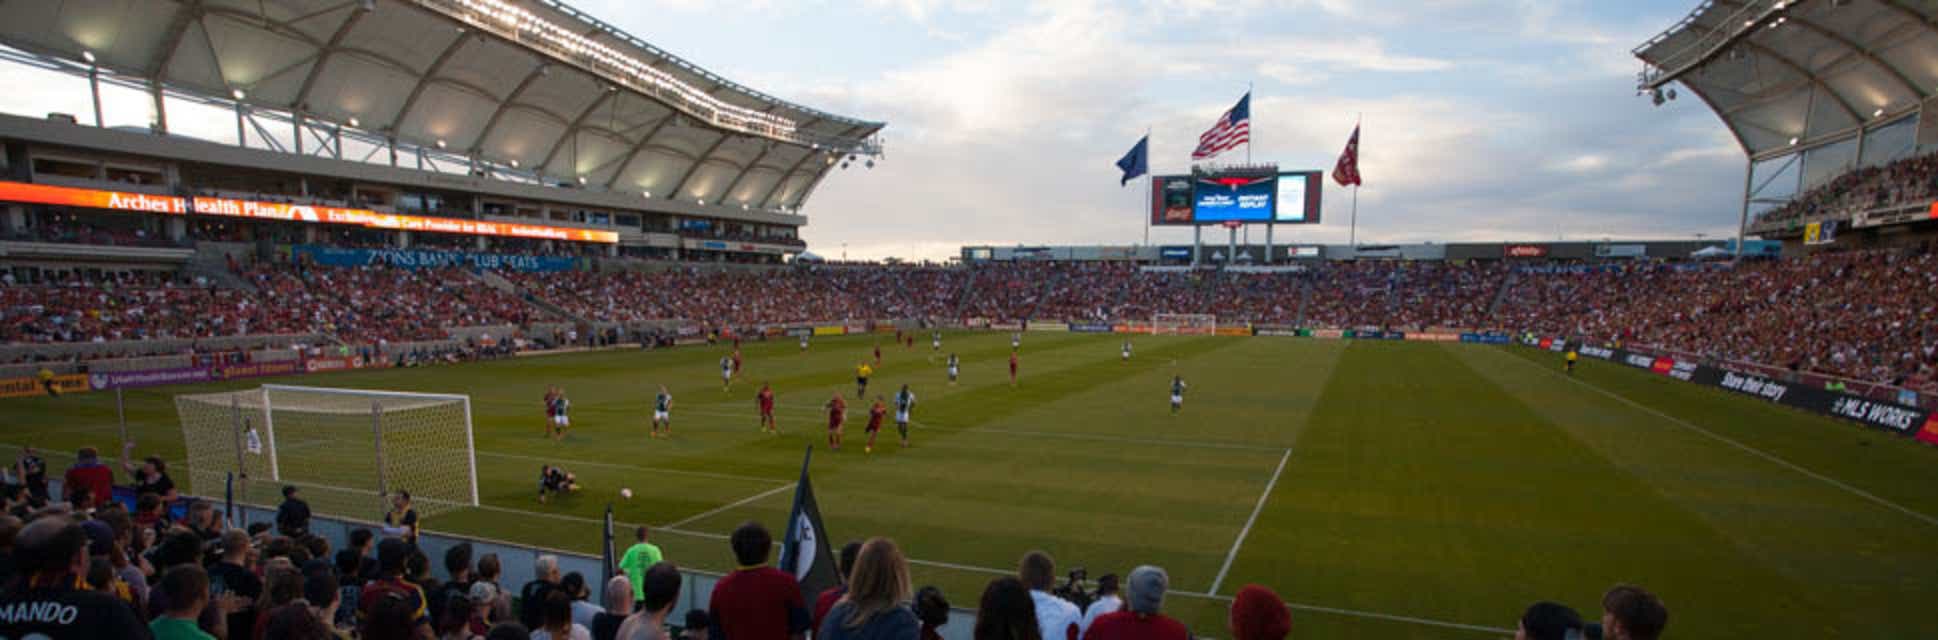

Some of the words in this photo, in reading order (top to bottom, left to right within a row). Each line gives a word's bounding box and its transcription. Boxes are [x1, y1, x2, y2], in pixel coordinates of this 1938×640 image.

[108, 192, 168, 212] Arches
[243, 201, 278, 218] Plan
[1840, 398, 1871, 418] MLS
[1867, 403, 1912, 430] WORKS
